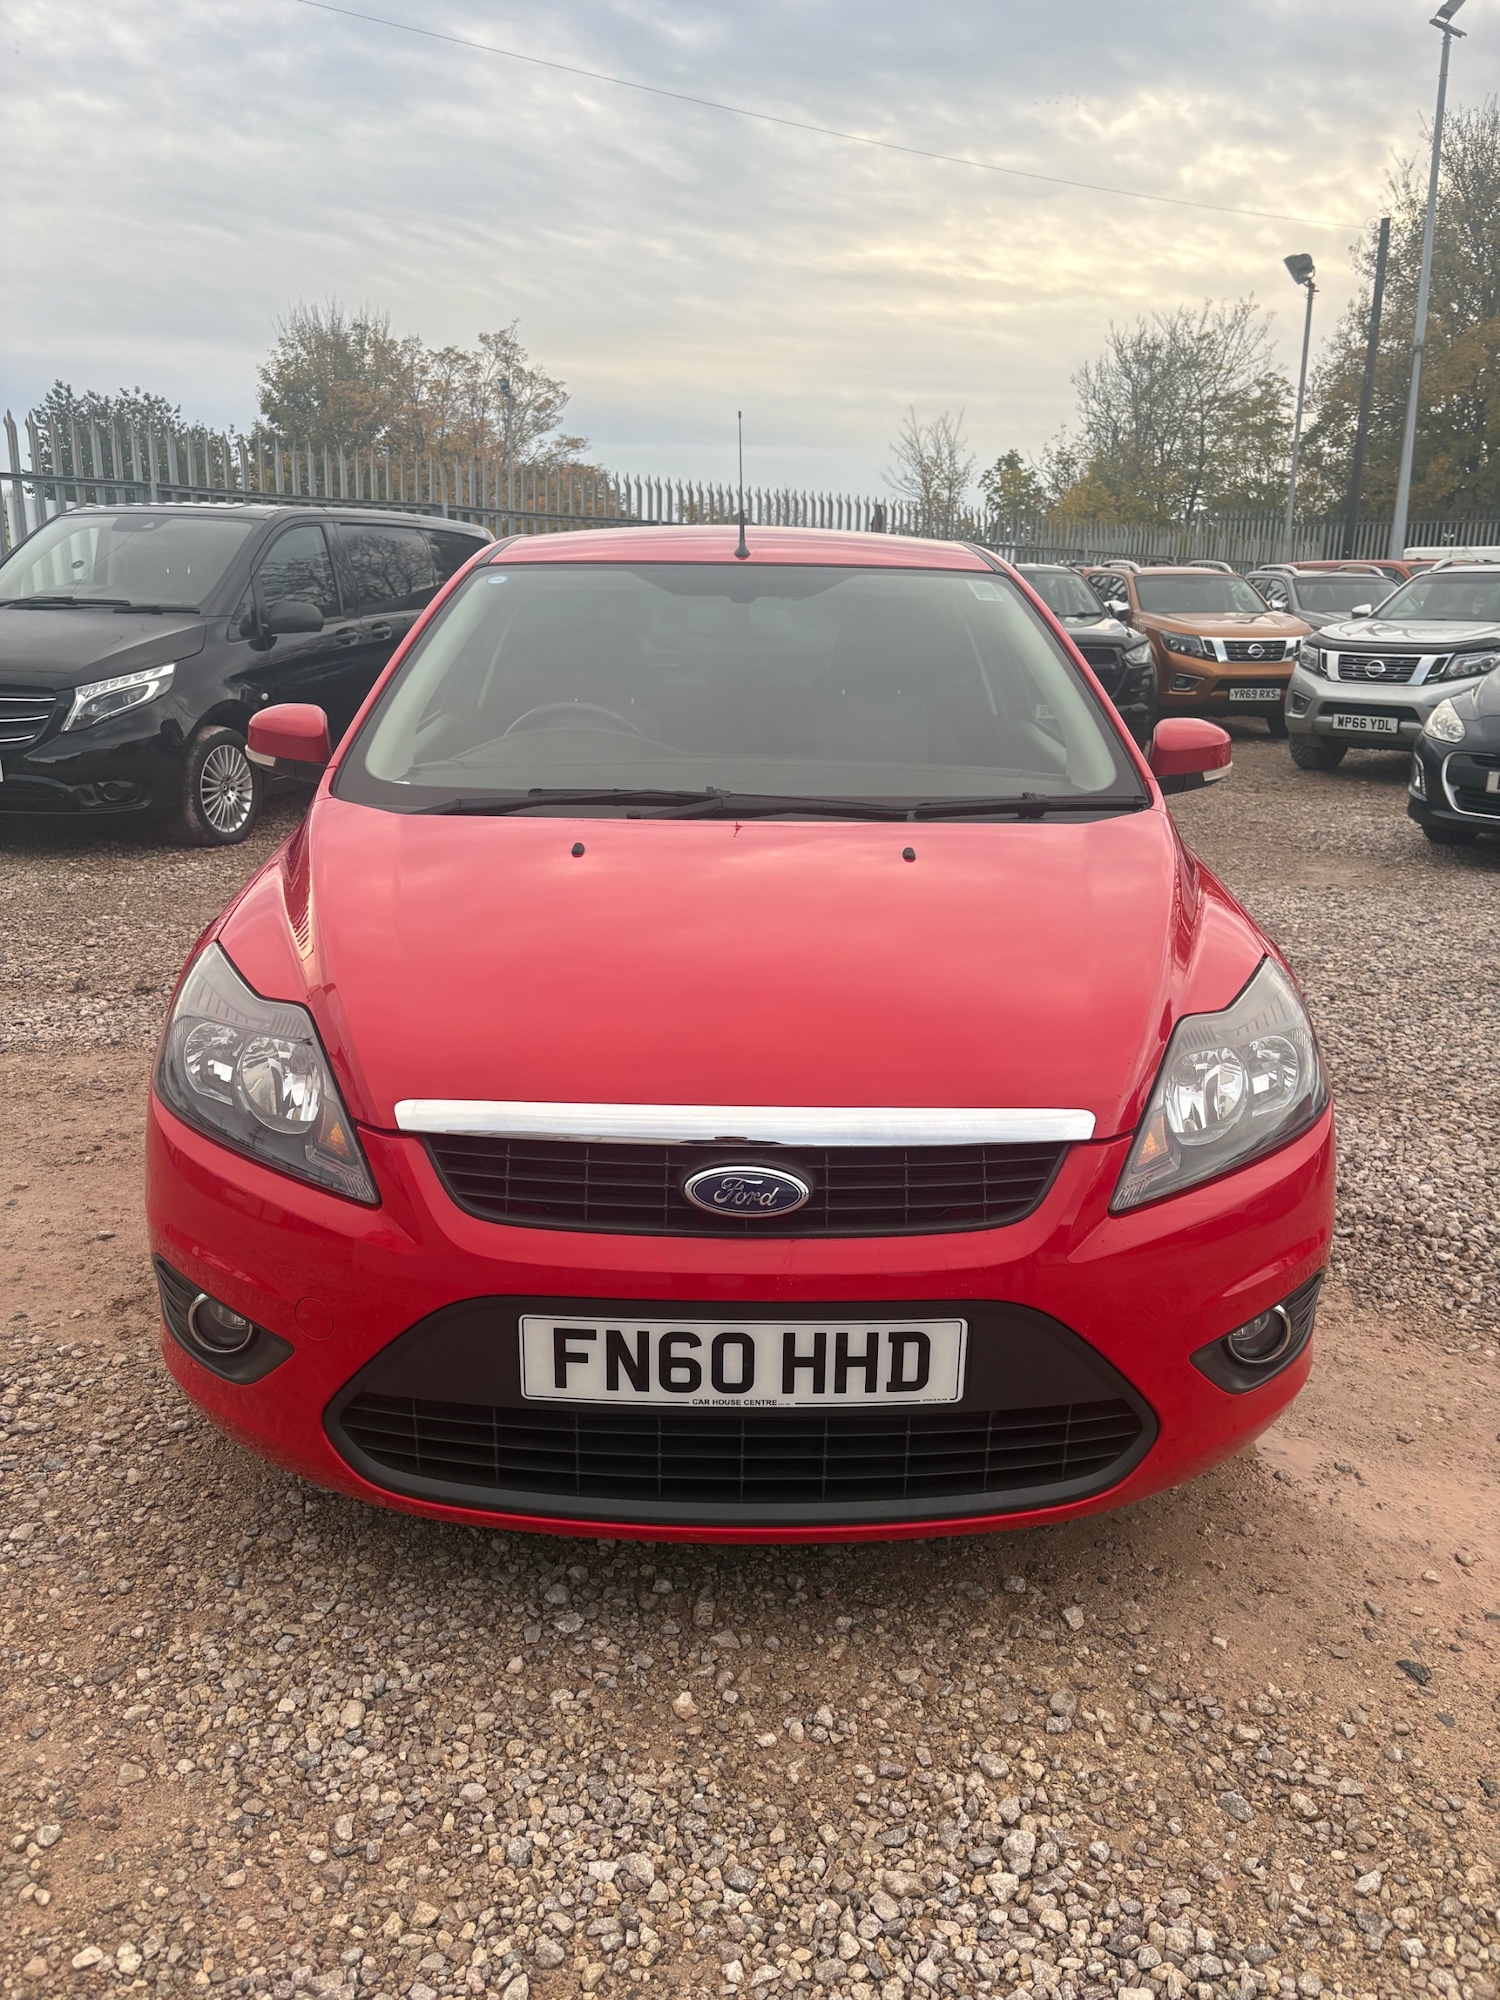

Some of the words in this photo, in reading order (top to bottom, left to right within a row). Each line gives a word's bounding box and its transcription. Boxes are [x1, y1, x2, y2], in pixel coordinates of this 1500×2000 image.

[1233, 689, 1258, 699] YR69
[1259, 689, 1277, 699] RXS
[1337, 716, 1367, 729] WP66
[1370, 718, 1392, 731] YDL
[713, 1177, 779, 1206] Ford
[553, 1327, 755, 1393] FN60
[782, 1331, 931, 1394] HHD
